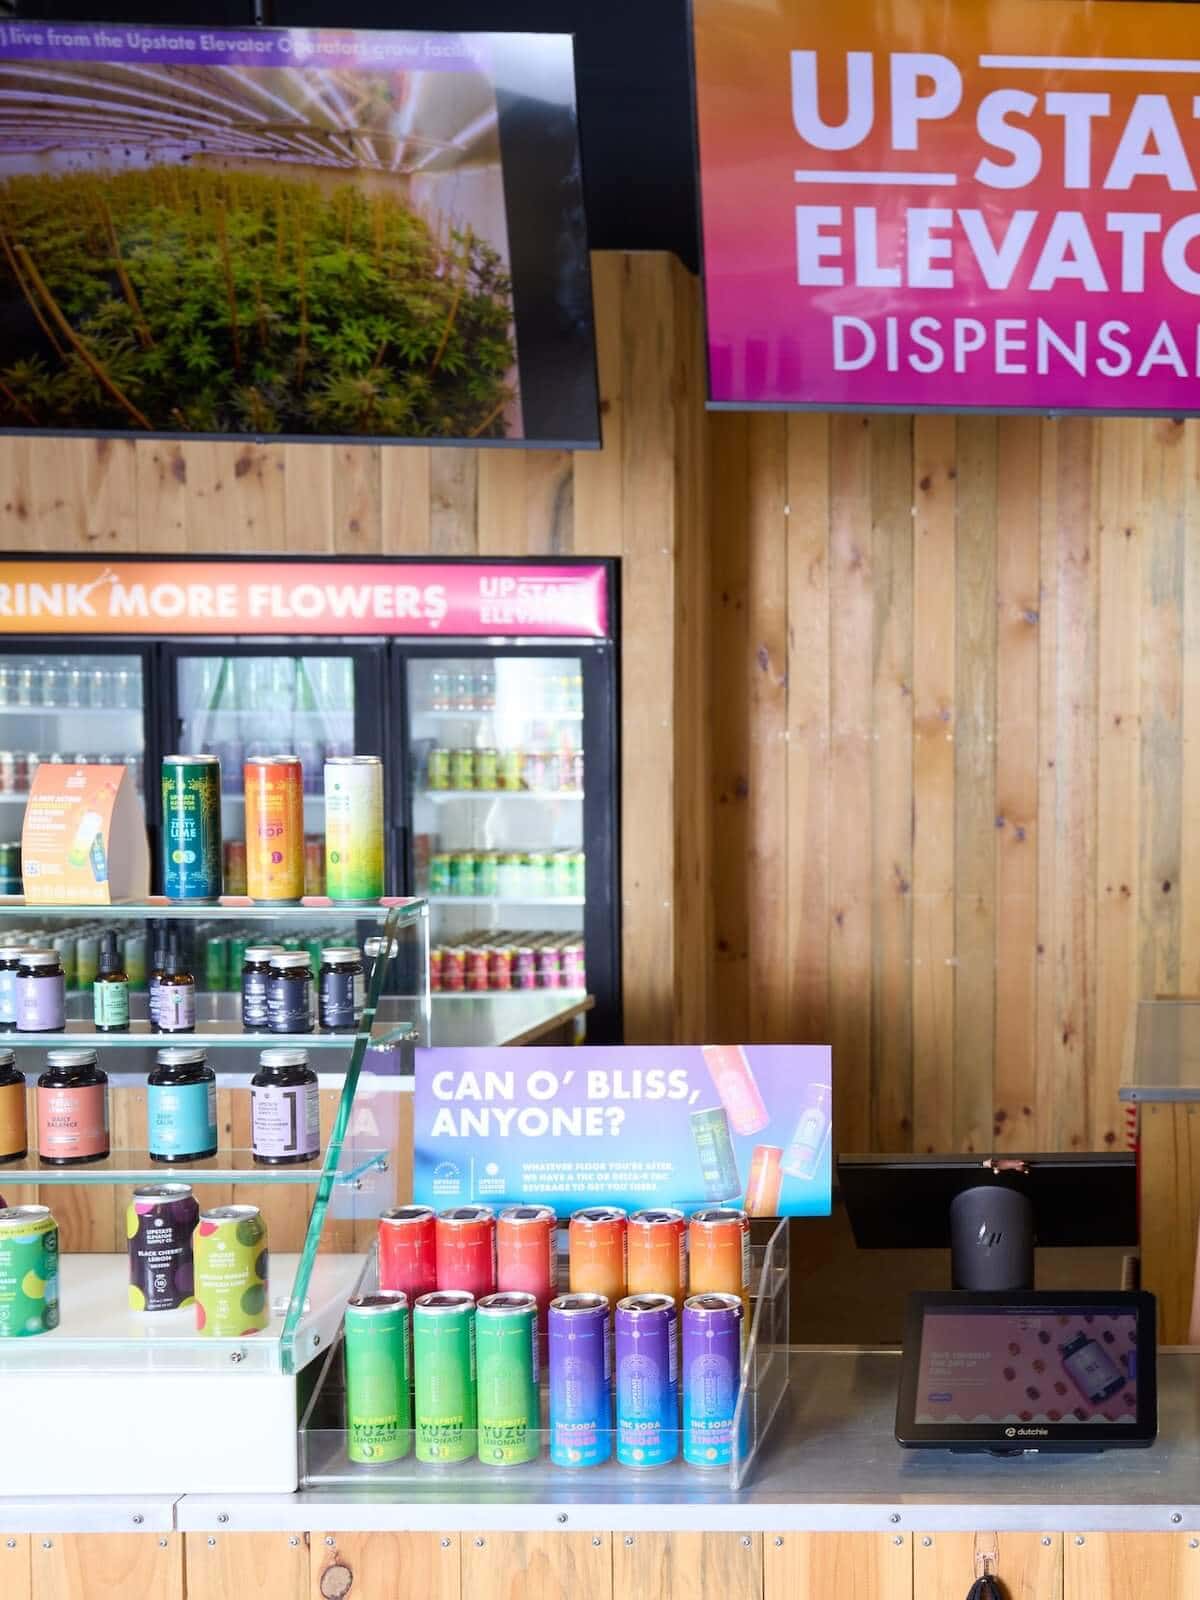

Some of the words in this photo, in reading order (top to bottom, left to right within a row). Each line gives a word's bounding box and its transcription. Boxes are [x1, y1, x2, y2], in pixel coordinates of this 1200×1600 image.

[10, 27, 42, 46] live
[49, 28, 90, 47] from
[95, 30, 123, 48] the
[126, 31, 196, 53] Upstate
[200, 34, 273, 51] Elevator
[108, 583, 238, 618] MORE
[249, 585, 447, 620] FLOWERS
[170, 829, 197, 838] LIME
[431, 1070, 515, 1101] CAN
[587, 1069, 701, 1105] BLISS,
[430, 1106, 627, 1137] ANYONE?
[353, 1421, 397, 1436] YUZU
[420, 1422, 463, 1437] YUZU
[484, 1424, 527, 1439] YUZU
[571, 1422, 596, 1431] SODA
[635, 1421, 661, 1431] SODA
[708, 1421, 733, 1429] SODA
[1017, 1427, 1049, 1436] dutchie
